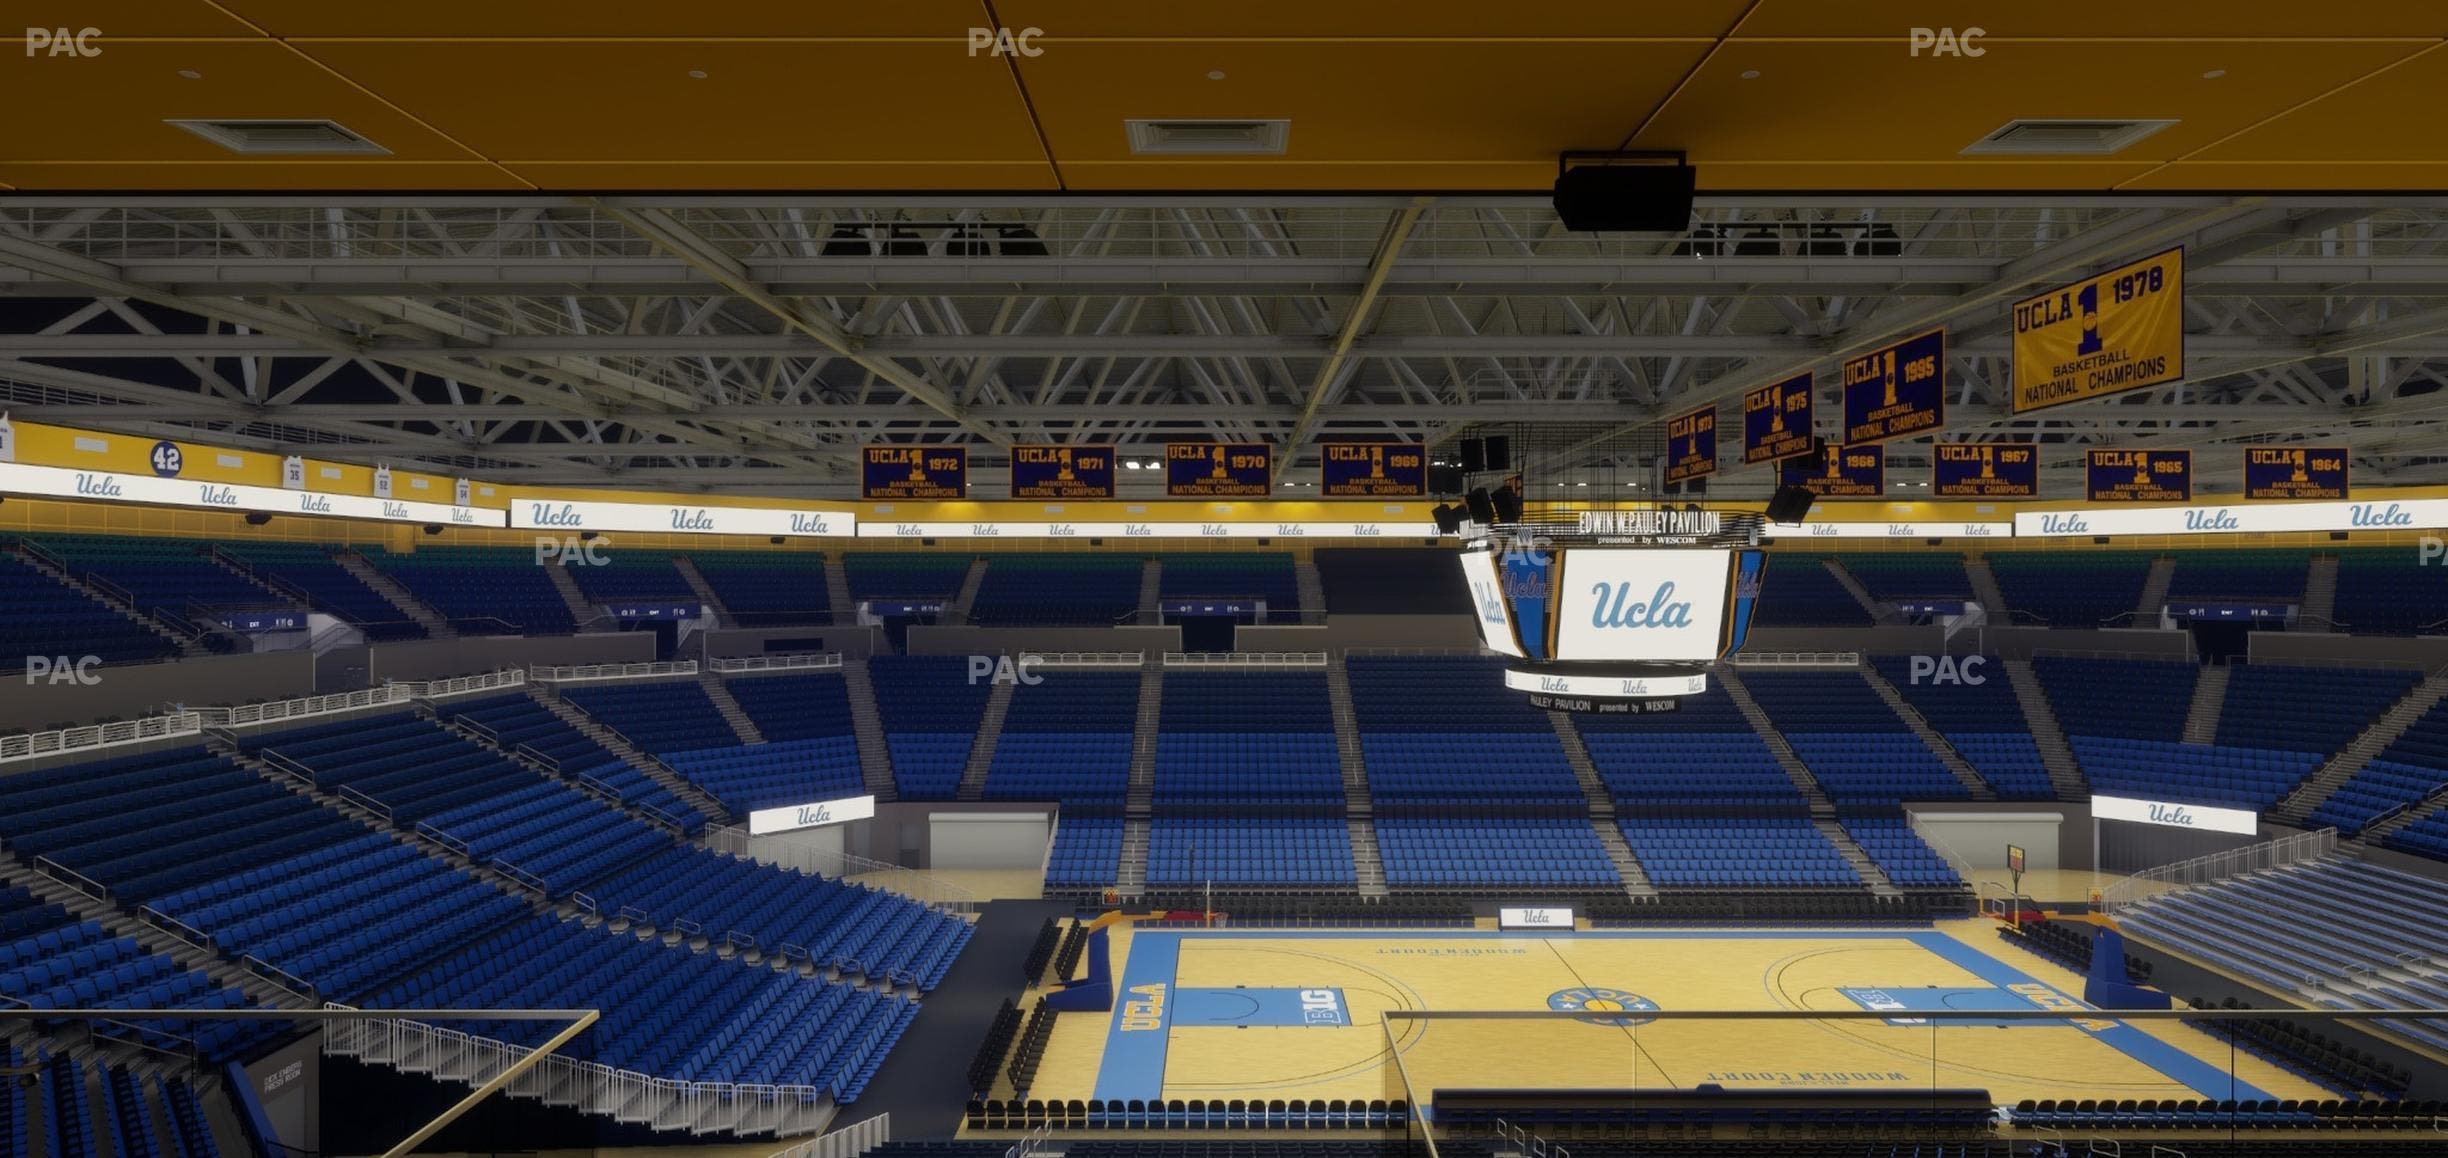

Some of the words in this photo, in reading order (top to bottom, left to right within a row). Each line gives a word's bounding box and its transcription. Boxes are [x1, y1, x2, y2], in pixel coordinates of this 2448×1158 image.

[2017, 293, 2073, 333] UCLA
[2113, 266, 2163, 303] 1978
[1846, 355, 1880, 386] UCLA
[1904, 355, 1935, 383] 1995
[2053, 349, 2130, 377] BASKETBALL
[2025, 377, 2078, 403] NATIONAL
[2088, 356, 2165, 390] CHAMPIONS
[1746, 390, 1770, 412] UCLA
[1786, 391, 1807, 412] 1975
[1868, 402, 1914, 422] BASKETBALL
[1670, 419, 1689, 438] UCLA
[1851, 422, 1884, 441] NATIONAL
[1889, 409, 1935, 432] CHAMPIONS
[1761, 430, 1793, 445] BASKETBALL
[1775, 436, 1807, 454] CHAMPIONS
[154, 447, 179, 470] 42
[870, 450, 908, 463] UCLA
[928, 458, 958, 470] 1972
[1018, 449, 1057, 462] UCLA
[1077, 458, 1104, 470] 1971
[1169, 446, 1206, 459] UCLA
[1232, 456, 1265, 468] 1970
[1329, 447, 1368, 460] UCLA
[1390, 456, 1418, 467] 1969
[1847, 456, 1875, 467] 1968
[1941, 447, 1979, 460] UCLA
[2000, 451, 2029, 463] 1967
[2094, 452, 2133, 466] UCLA
[2153, 461, 2183, 473] 1965
[2252, 450, 2291, 464] UCLA
[2311, 459, 2340, 471] 1964
[290, 470, 299, 480] 35
[76, 473, 122, 497] Ucla
[870, 488, 907, 497] NATIONAL
[913, 488, 958, 497] CHAMPIONS
[1019, 487, 1055, 497] NATIONAL
[1062, 488, 1107, 497] CHAMPIONS
[1172, 485, 1213, 494] NATIONAL
[1215, 485, 1265, 495] CHAMPIONS
[1330, 485, 1366, 494] NATIONAL
[1372, 485, 1417, 494] CHAMPIONS
[1830, 485, 1875, 493] CHAMPIONS
[1942, 485, 1978, 493] NATIONAL
[1984, 485, 2029, 493] CHAMPIONS
[2253, 489, 2289, 498] NATIONAL
[2295, 489, 2340, 498] CHAMPIONS
[200, 484, 238, 505] Ucla
[300, 493, 332, 512] Ucla
[2095, 490, 2132, 499] NATIONAL
[2137, 491, 2183, 500] CHAMPIONS
[383, 501, 408, 518] Ucla
[451, 508, 473, 523] Ucla
[532, 502, 582, 526] Ucla
[2350, 503, 2412, 527] Ucla
[671, 509, 714, 530] Ucla
[790, 513, 828, 533] Ucla
[1580, 511, 1613, 534] EDWIN
[1629, 511, 1667, 534] PAULEY
[1669, 511, 1720, 534] PAVILION
[2041, 514, 2089, 534] Ucla
[2185, 509, 2239, 530] Ucla
[896, 524, 922, 536] Ucla
[972, 524, 999, 536] Ucla
[1049, 524, 1075, 536] Ucla
[1125, 524, 1151, 536] Ucla
[1201, 524, 1227, 536] Ucla
[1278, 524, 1304, 536] Ucla
[1354, 524, 1380, 536] Ucla
[1812, 524, 1838, 536] Ucla
[1888, 524, 1914, 536] Ucla
[1965, 524, 1990, 536] Ucla
[1598, 537, 1635, 545] presented
[1642, 536, 1651, 545] by
[1501, 571, 1549, 599] Ucla
[1592, 581, 1693, 629] Ucla
[1541, 677, 1569, 693] Ucla
[1622, 680, 1648, 694] Ucla
[1555, 698, 1591, 711] PAVILION
[1599, 703, 1628, 713] presented
[1632, 704, 1639, 713] by
[1645, 700, 1675, 712] WESCOM
[797, 805, 831, 825] Ucla
[2149, 804, 2193, 825] Ucla
[1524, 910, 1549, 923] Ucla
[1120, 983, 1166, 1031] UCLA
